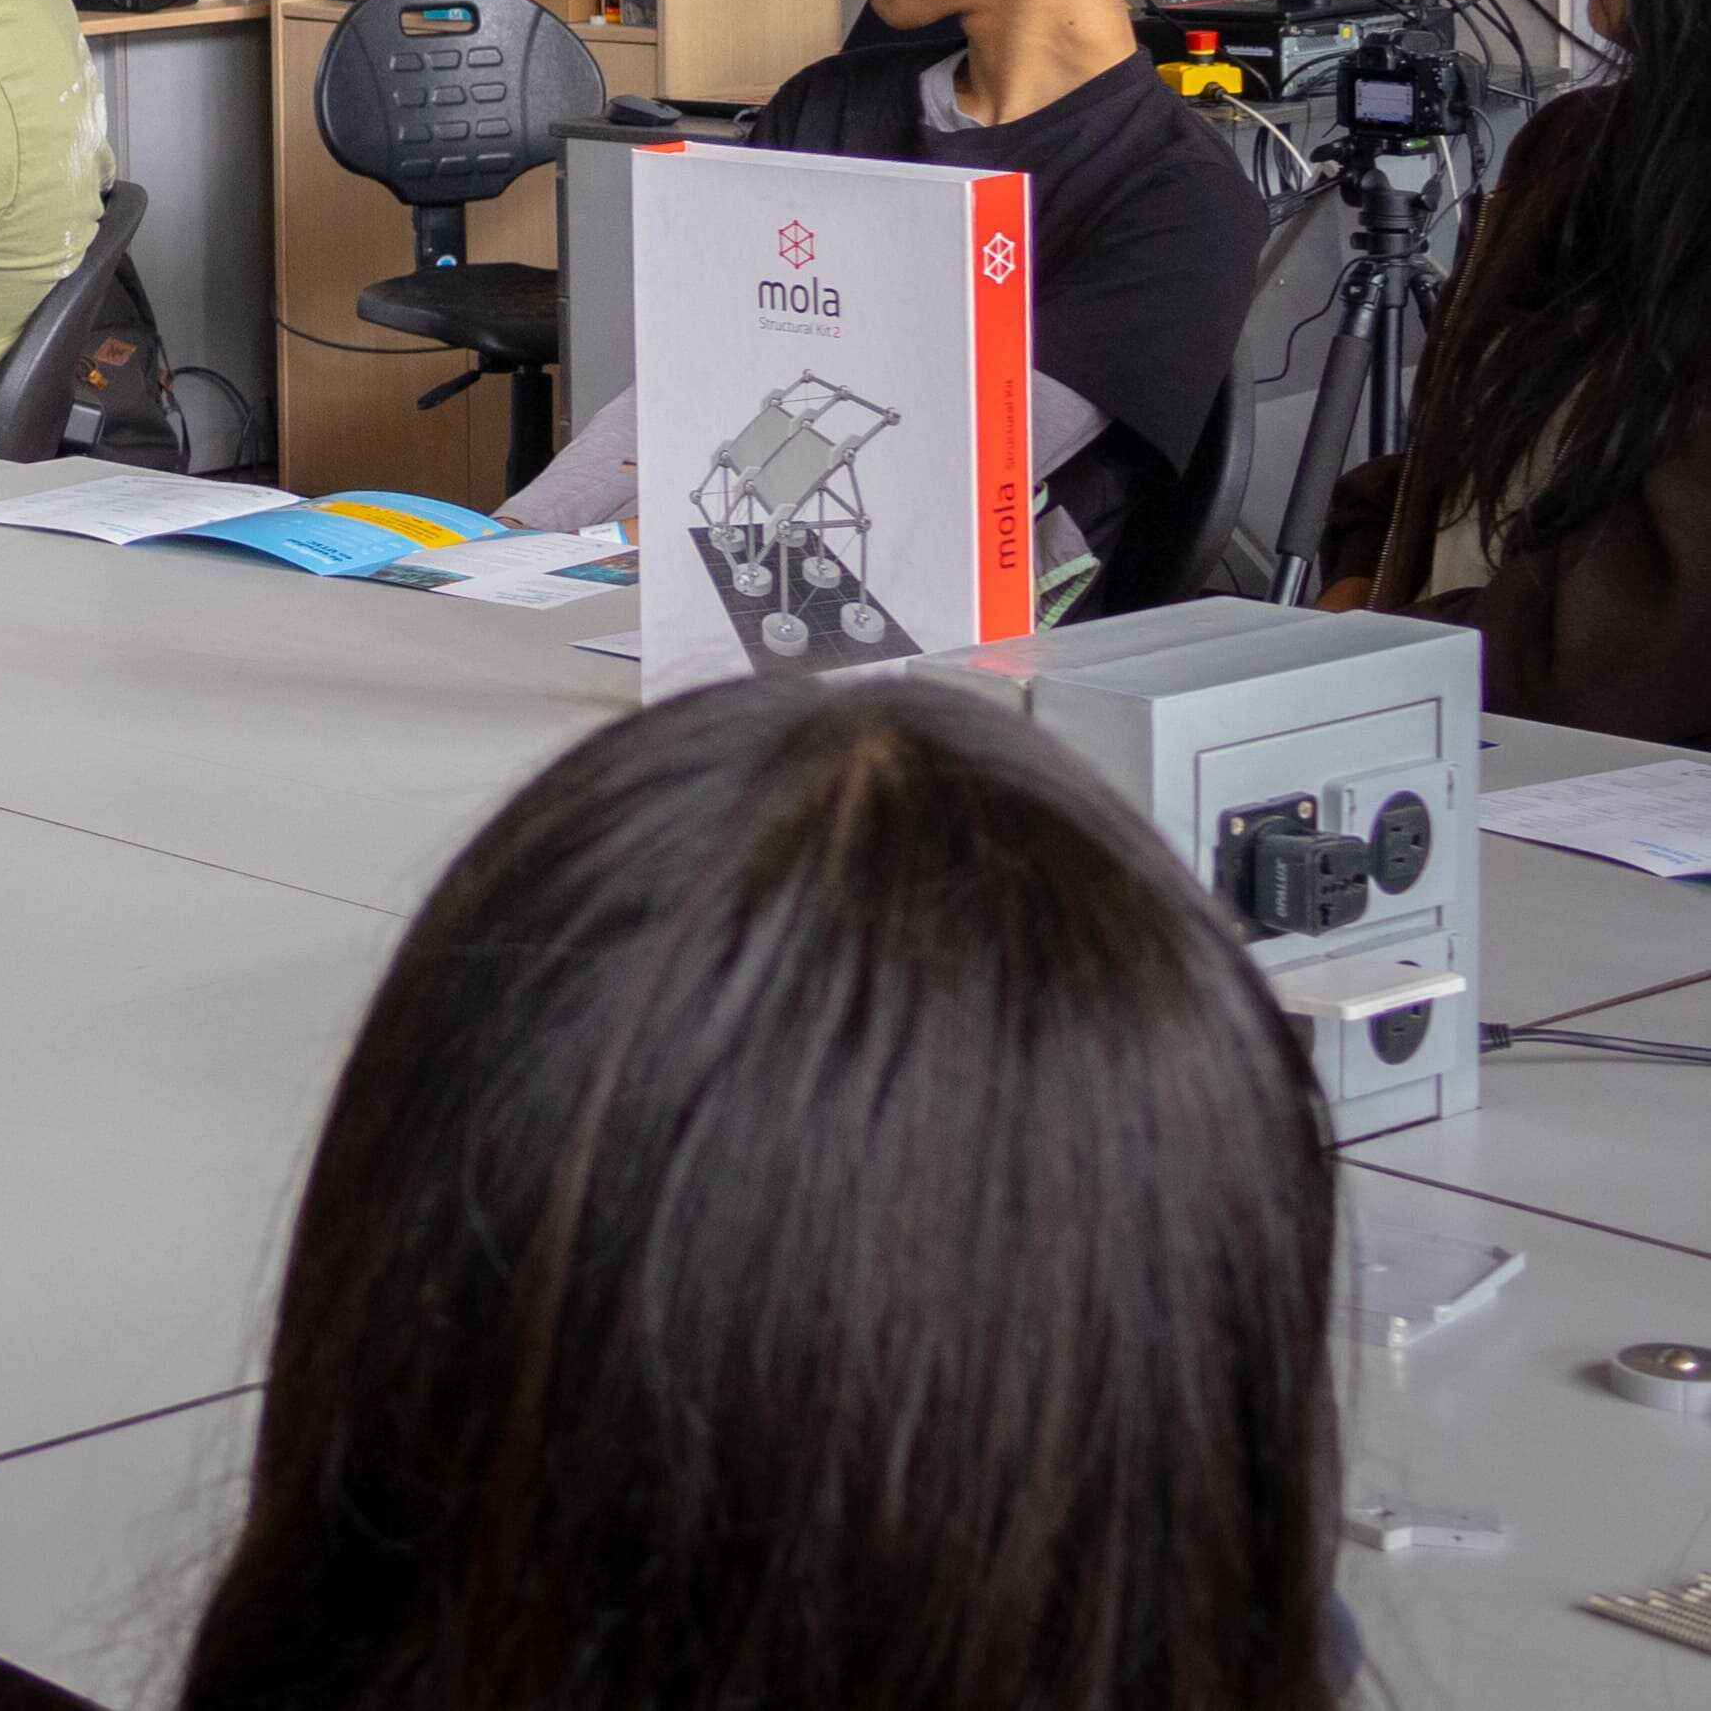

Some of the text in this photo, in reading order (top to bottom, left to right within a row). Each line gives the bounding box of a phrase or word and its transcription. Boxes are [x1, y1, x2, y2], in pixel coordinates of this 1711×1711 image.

[759, 276, 841, 319] mola
[759, 315, 842, 339] Structural Kit 2
[994, 482, 1017, 571] mola
